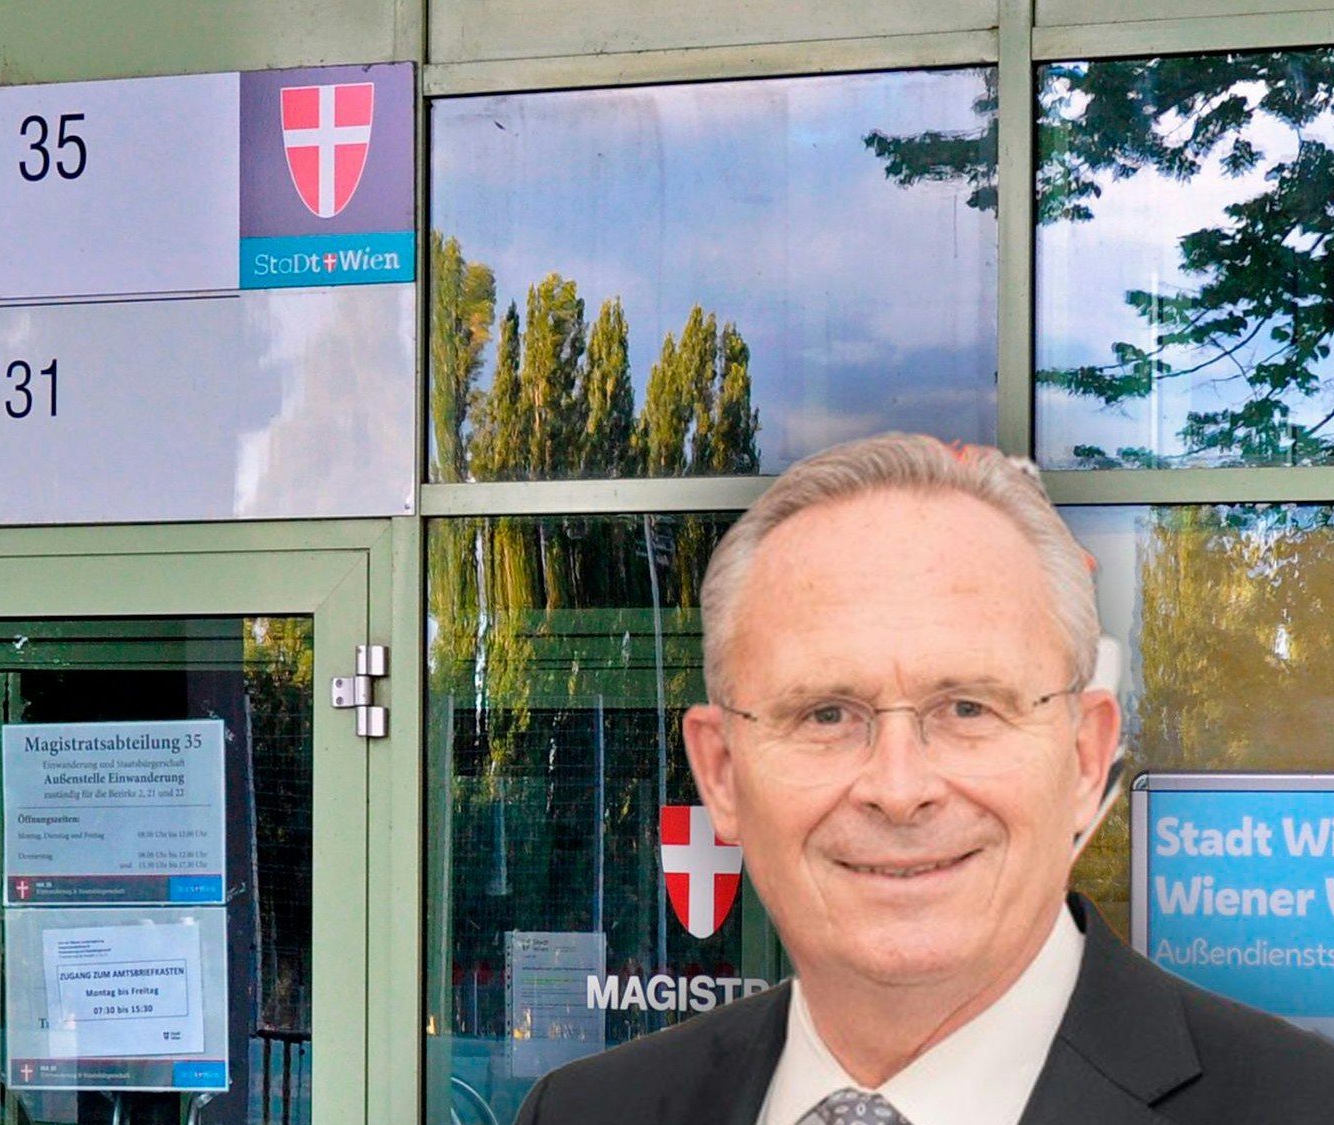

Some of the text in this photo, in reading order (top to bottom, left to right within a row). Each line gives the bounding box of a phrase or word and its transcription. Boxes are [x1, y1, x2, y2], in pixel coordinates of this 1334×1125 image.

[19, 113, 87, 181] 35
[339, 247, 400, 272] Wien
[5, 358, 59, 419] 31
[24, 733, 202, 757] Magistratsabteilung 35
[42, 759, 98, 770] Einwanderung
[99, 759, 115, 769] und
[44, 771, 185, 786] Außenstelle Einwanderung
[1155, 815, 1273, 858] Stadt
[1155, 875, 1315, 917] Wiener
[60, 967, 185, 981] ZUGANG ZUM AMTSBRIEFKASTEN
[85, 986, 159, 998] Montag bis Freitag
[117, 1004, 129, 1014] bis
[131, 1004, 153, 1014] 15:30
